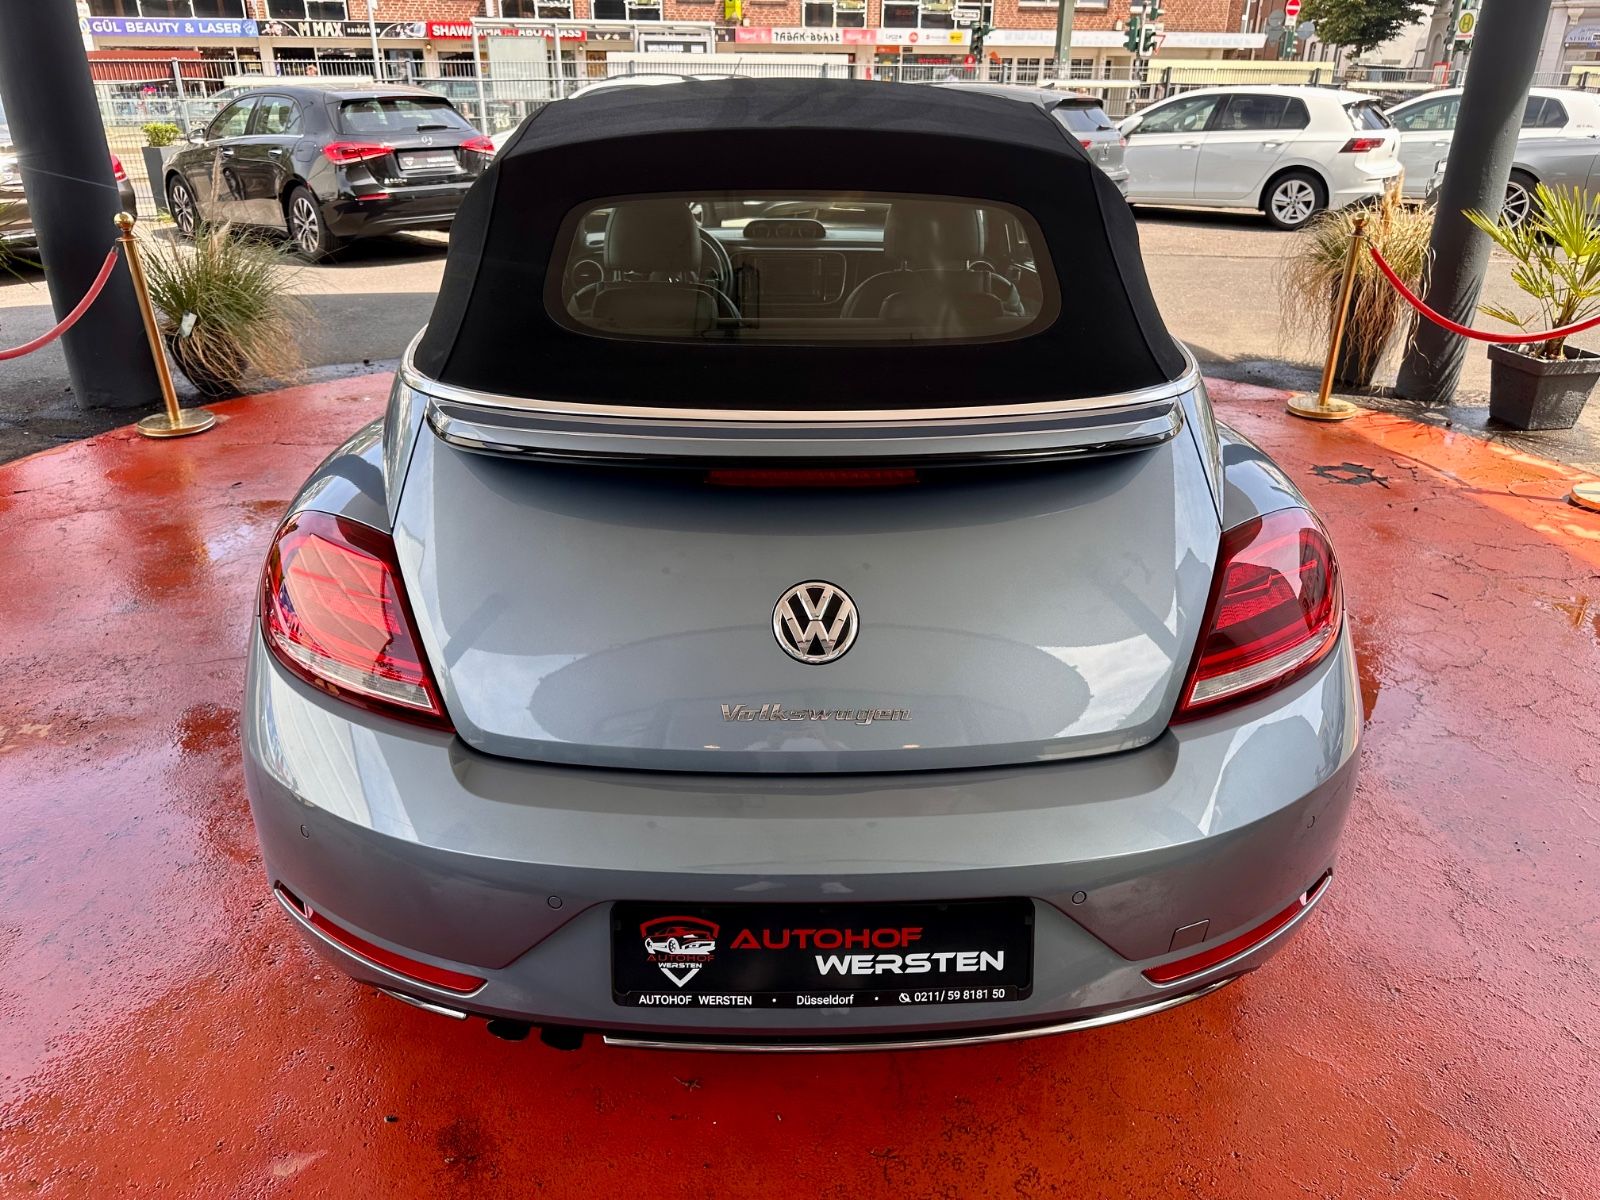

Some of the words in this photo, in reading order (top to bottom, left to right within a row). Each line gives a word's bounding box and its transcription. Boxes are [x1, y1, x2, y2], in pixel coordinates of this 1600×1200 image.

[92, 19, 122, 33] GÜL
[126, 21, 179, 34] BEAUTY
[185, 22, 195, 33] &
[198, 22, 242, 34] LASER
[298, 22, 311, 37] M
[313, 22, 344, 37] MAX
[720, 703, 913, 725] Volkswagen
[730, 927, 923, 950] AUTOHOF
[647, 954, 715, 962] AUTOHOF
[815, 950, 1005, 976] WERSTEN
[638, 995, 693, 1005] AUTOHOF
[698, 995, 753, 1006] WERSTEN
[796, 994, 854, 1005] Düsseldorf
[914, 990, 946, 1002] 0211/
[947, 990, 961, 1001] 59
[962, 989, 988, 1000] 8181
[992, 988, 1006, 999] 50
